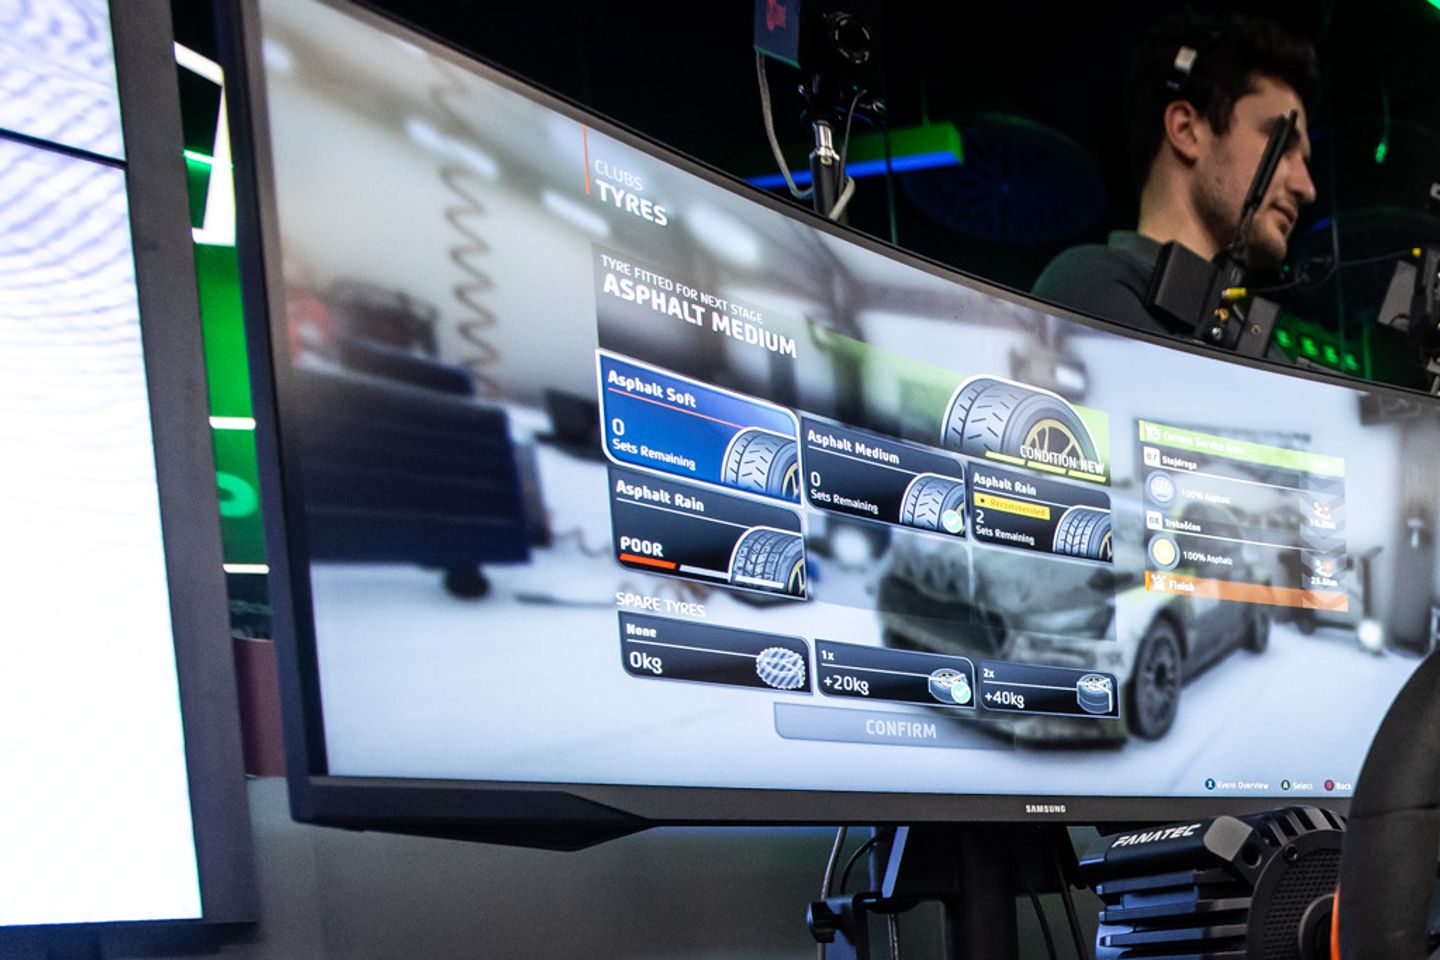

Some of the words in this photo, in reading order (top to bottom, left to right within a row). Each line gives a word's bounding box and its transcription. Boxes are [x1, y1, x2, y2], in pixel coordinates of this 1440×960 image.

[594, 160, 644, 193] CLUBS
[595, 179, 669, 227] TYRES
[601, 254, 631, 277] TYRE
[634, 267, 673, 291] FITTED
[676, 283, 698, 301] FOR
[700, 292, 728, 311] NEXT
[730, 304, 763, 325] STAGE
[603, 273, 705, 326] ASPHALT
[711, 311, 797, 358] MEDIUM
[608, 370, 663, 399] Asphalt
[667, 389, 697, 408] Soft
[612, 418, 625, 436] 0
[612, 438, 638, 455] Sets
[640, 446, 696, 471] Remaining
[808, 429, 852, 453] Asphalt
[855, 442, 900, 464] Medium
[811, 471, 821, 487] 0
[974, 473, 1012, 491] Asphalt
[1015, 481, 1037, 496] Rain
[616, 480, 670, 504] Asphalt
[674, 495, 705, 512] Rain
[810, 489, 831, 504] Sets
[833, 495, 879, 515] Remaining
[976, 510, 984, 523] 2
[620, 536, 664, 556] POOR
[976, 525, 994, 538] Sets
[995, 529, 1035, 546] Remaining
[1184, 551, 1205, 562] 100%
[615, 592, 660, 611] SPARE
[665, 601, 706, 618] TYRES
[626, 623, 657, 638] None
[630, 651, 662, 675] 0kg
[821, 650, 834, 661] 1x
[983, 668, 995, 679] 2x
[824, 676, 869, 696] +20kg
[985, 691, 1025, 709] +40kg
[866, 720, 937, 739] CONFIRM
[1026, 805, 1066, 813] SAMSUNG
[1112, 823, 1202, 848] FANATEC
